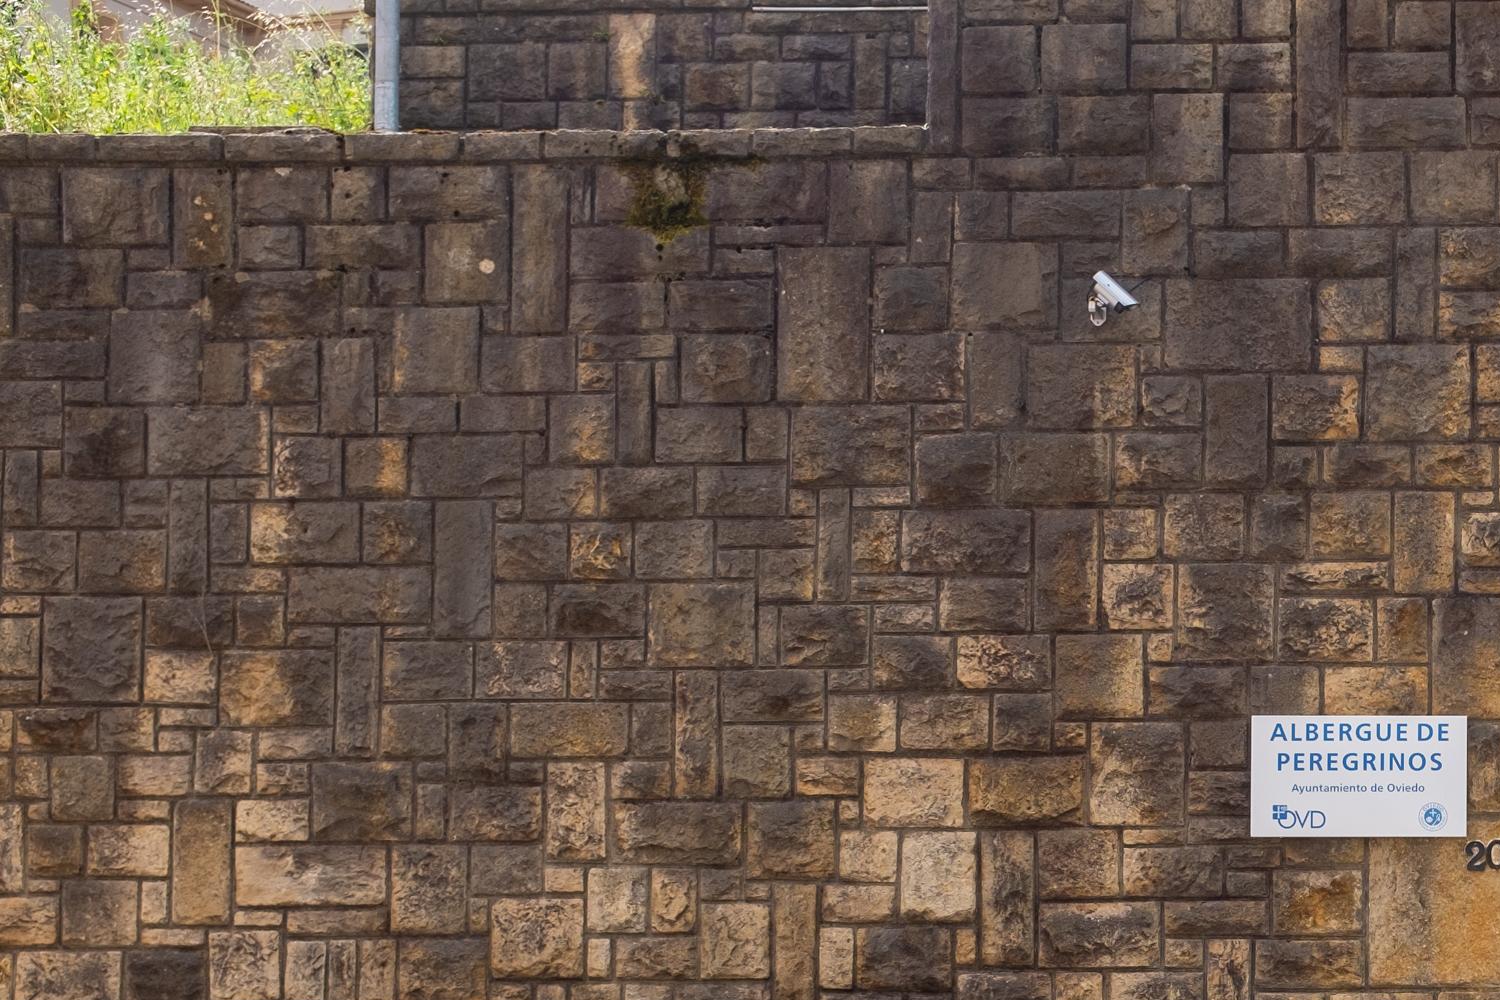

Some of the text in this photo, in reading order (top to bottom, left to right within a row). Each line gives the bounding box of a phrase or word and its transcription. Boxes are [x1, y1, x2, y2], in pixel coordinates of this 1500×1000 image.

[1270, 723, 1449, 742] ALBERGUE DE
[1277, 752, 1443, 771] PEREGRINOS
[1291, 783, 1425, 793] Ayuntamiento de Oviedo
[1278, 810, 1326, 829] OVD
